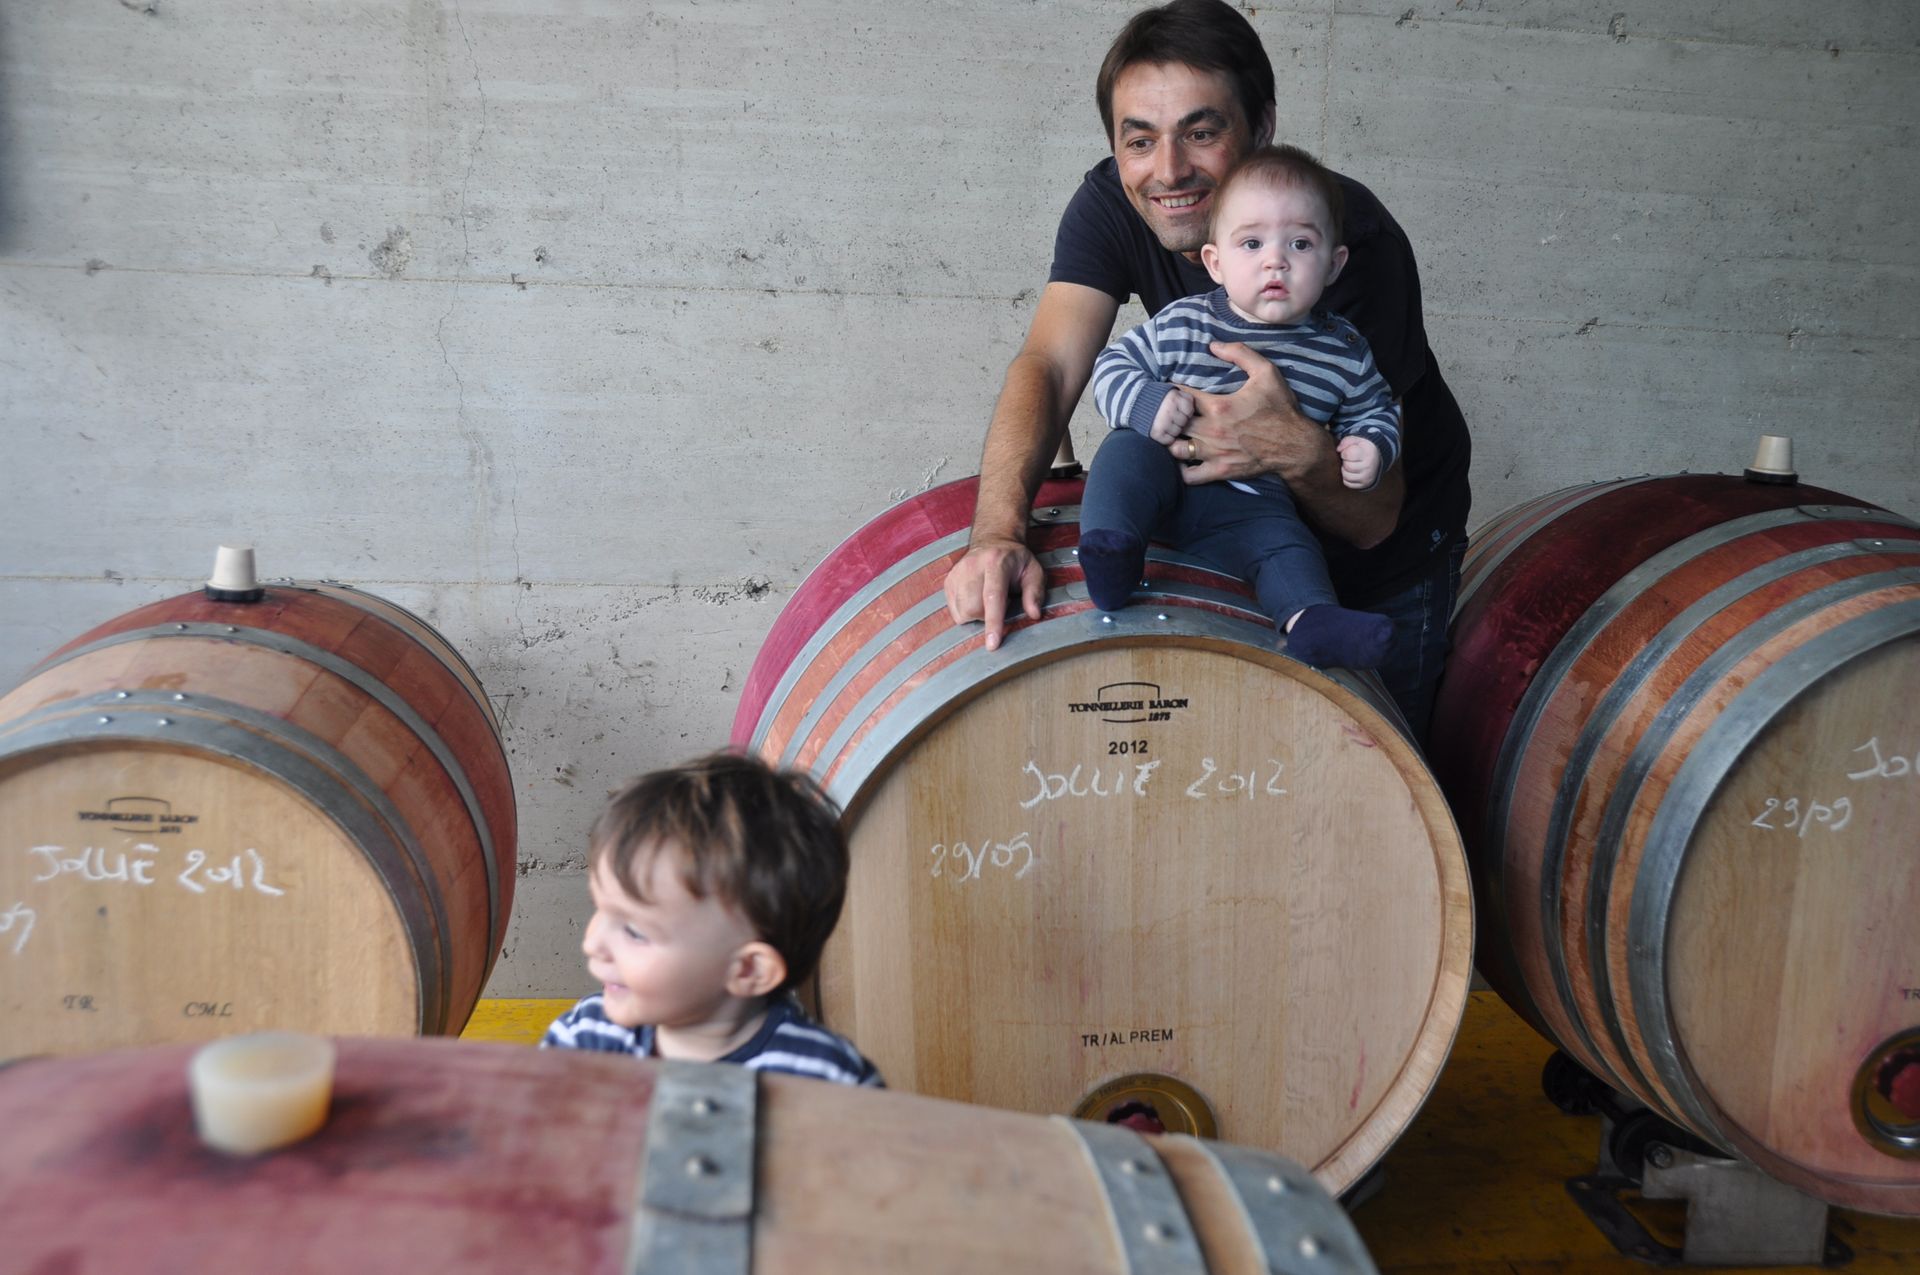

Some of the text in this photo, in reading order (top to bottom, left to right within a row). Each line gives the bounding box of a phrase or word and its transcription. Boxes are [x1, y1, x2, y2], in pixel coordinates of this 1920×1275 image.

[1068, 698, 1188, 713] TONNELLERIE BARON
[1108, 740, 1148, 754] 2012
[1186, 757, 1289, 799] 2012
[178, 850, 285, 896] 2012
[1130, 1029, 1174, 1044] PREM
